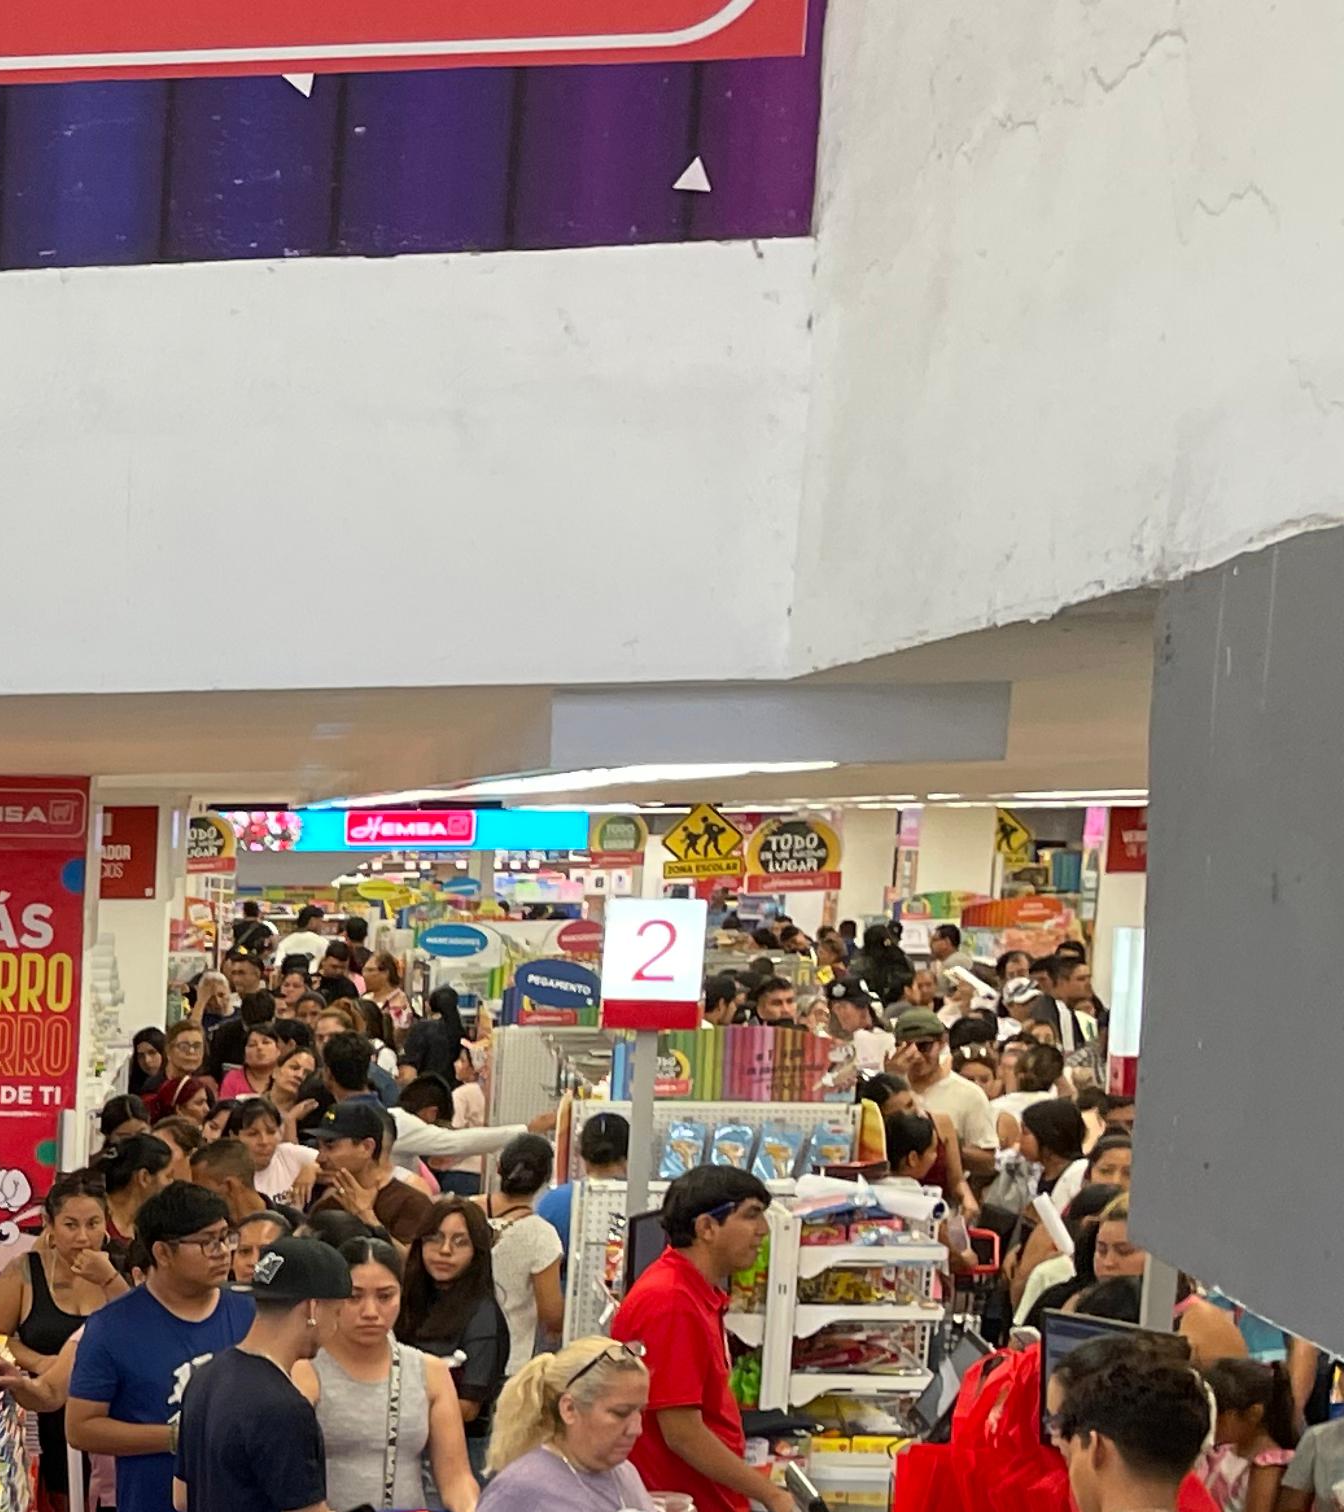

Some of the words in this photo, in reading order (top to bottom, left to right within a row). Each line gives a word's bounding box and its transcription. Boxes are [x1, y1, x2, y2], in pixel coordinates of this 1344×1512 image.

[350, 816, 447, 841] HEMSA
[768, 833, 818, 850] TODO
[667, 865, 693, 875] ZONA
[695, 862, 738, 873] ESCOLAR
[768, 858, 818, 873] LUGAR
[632, 919, 678, 982] 2
[527, 973, 592, 996] PEGAMENTO
[0, 1085, 32, 1105] DE
[39, 1086, 61, 1105] TI
